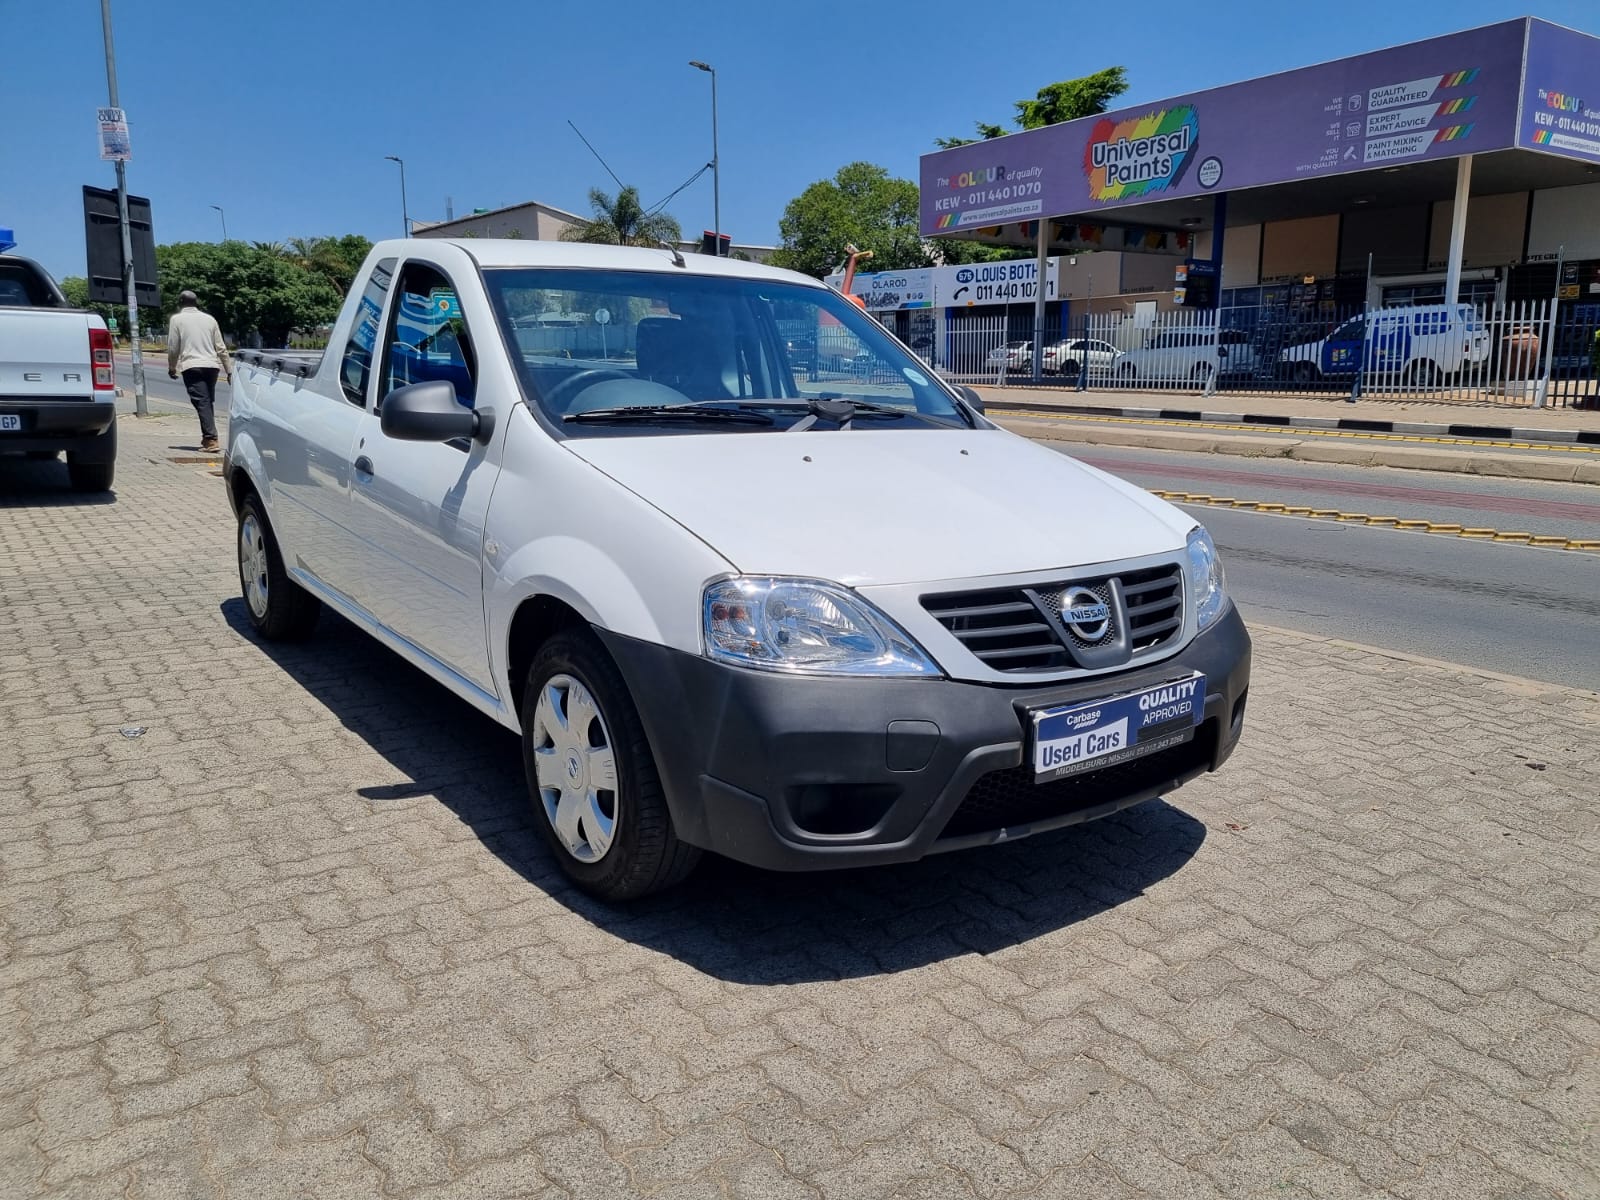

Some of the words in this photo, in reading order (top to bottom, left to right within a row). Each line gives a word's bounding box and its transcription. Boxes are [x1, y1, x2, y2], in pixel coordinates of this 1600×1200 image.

[1371, 86, 1407, 99] QUALITY
[1371, 91, 1428, 107] GUARANTEED
[1547, 90, 1585, 113] COLOUR
[1324, 103, 1342, 112] MAKE
[1369, 113, 1402, 125] EXPERT
[1369, 122, 1395, 133] PAINT
[1395, 117, 1426, 129] ADVICE
[1534, 111, 1554, 127] KEW
[1558, 116, 1571, 130] 011
[1571, 120, 1586, 133] 440
[1093, 126, 1189, 167] Universal
[1367, 141, 1392, 152] PAINT
[1393, 136, 1424, 148] MIXING
[1373, 146, 1417, 158] MATCHING
[1106, 156, 1171, 186] Paints
[1312, 160, 1338, 170] QUALITY
[937, 177, 949, 188] The
[949, 165, 1006, 190] COLOUR
[1006, 171, 1016, 181] of
[1016, 166, 1043, 180] quality
[935, 196, 960, 211] KEW
[969, 190, 986, 205] 011
[988, 187, 1010, 201] 440
[1012, 181, 1041, 197] 1070
[975, 266, 1006, 283] LOUIS
[1010, 264, 1038, 280] BOTH
[976, 285, 992, 300] 011
[996, 282, 1017, 299] 440
[2, 416, 17, 429] GP
[1070, 607, 1108, 620] NISSAN
[1139, 680, 1198, 711] QUALITY
[1142, 700, 1192, 726] APPROVED
[1042, 737, 1081, 767] Used
[1087, 730, 1120, 756] Cars
[1055, 757, 1107, 776] MIDDELBURG
[1108, 750, 1135, 765] NISSAN
